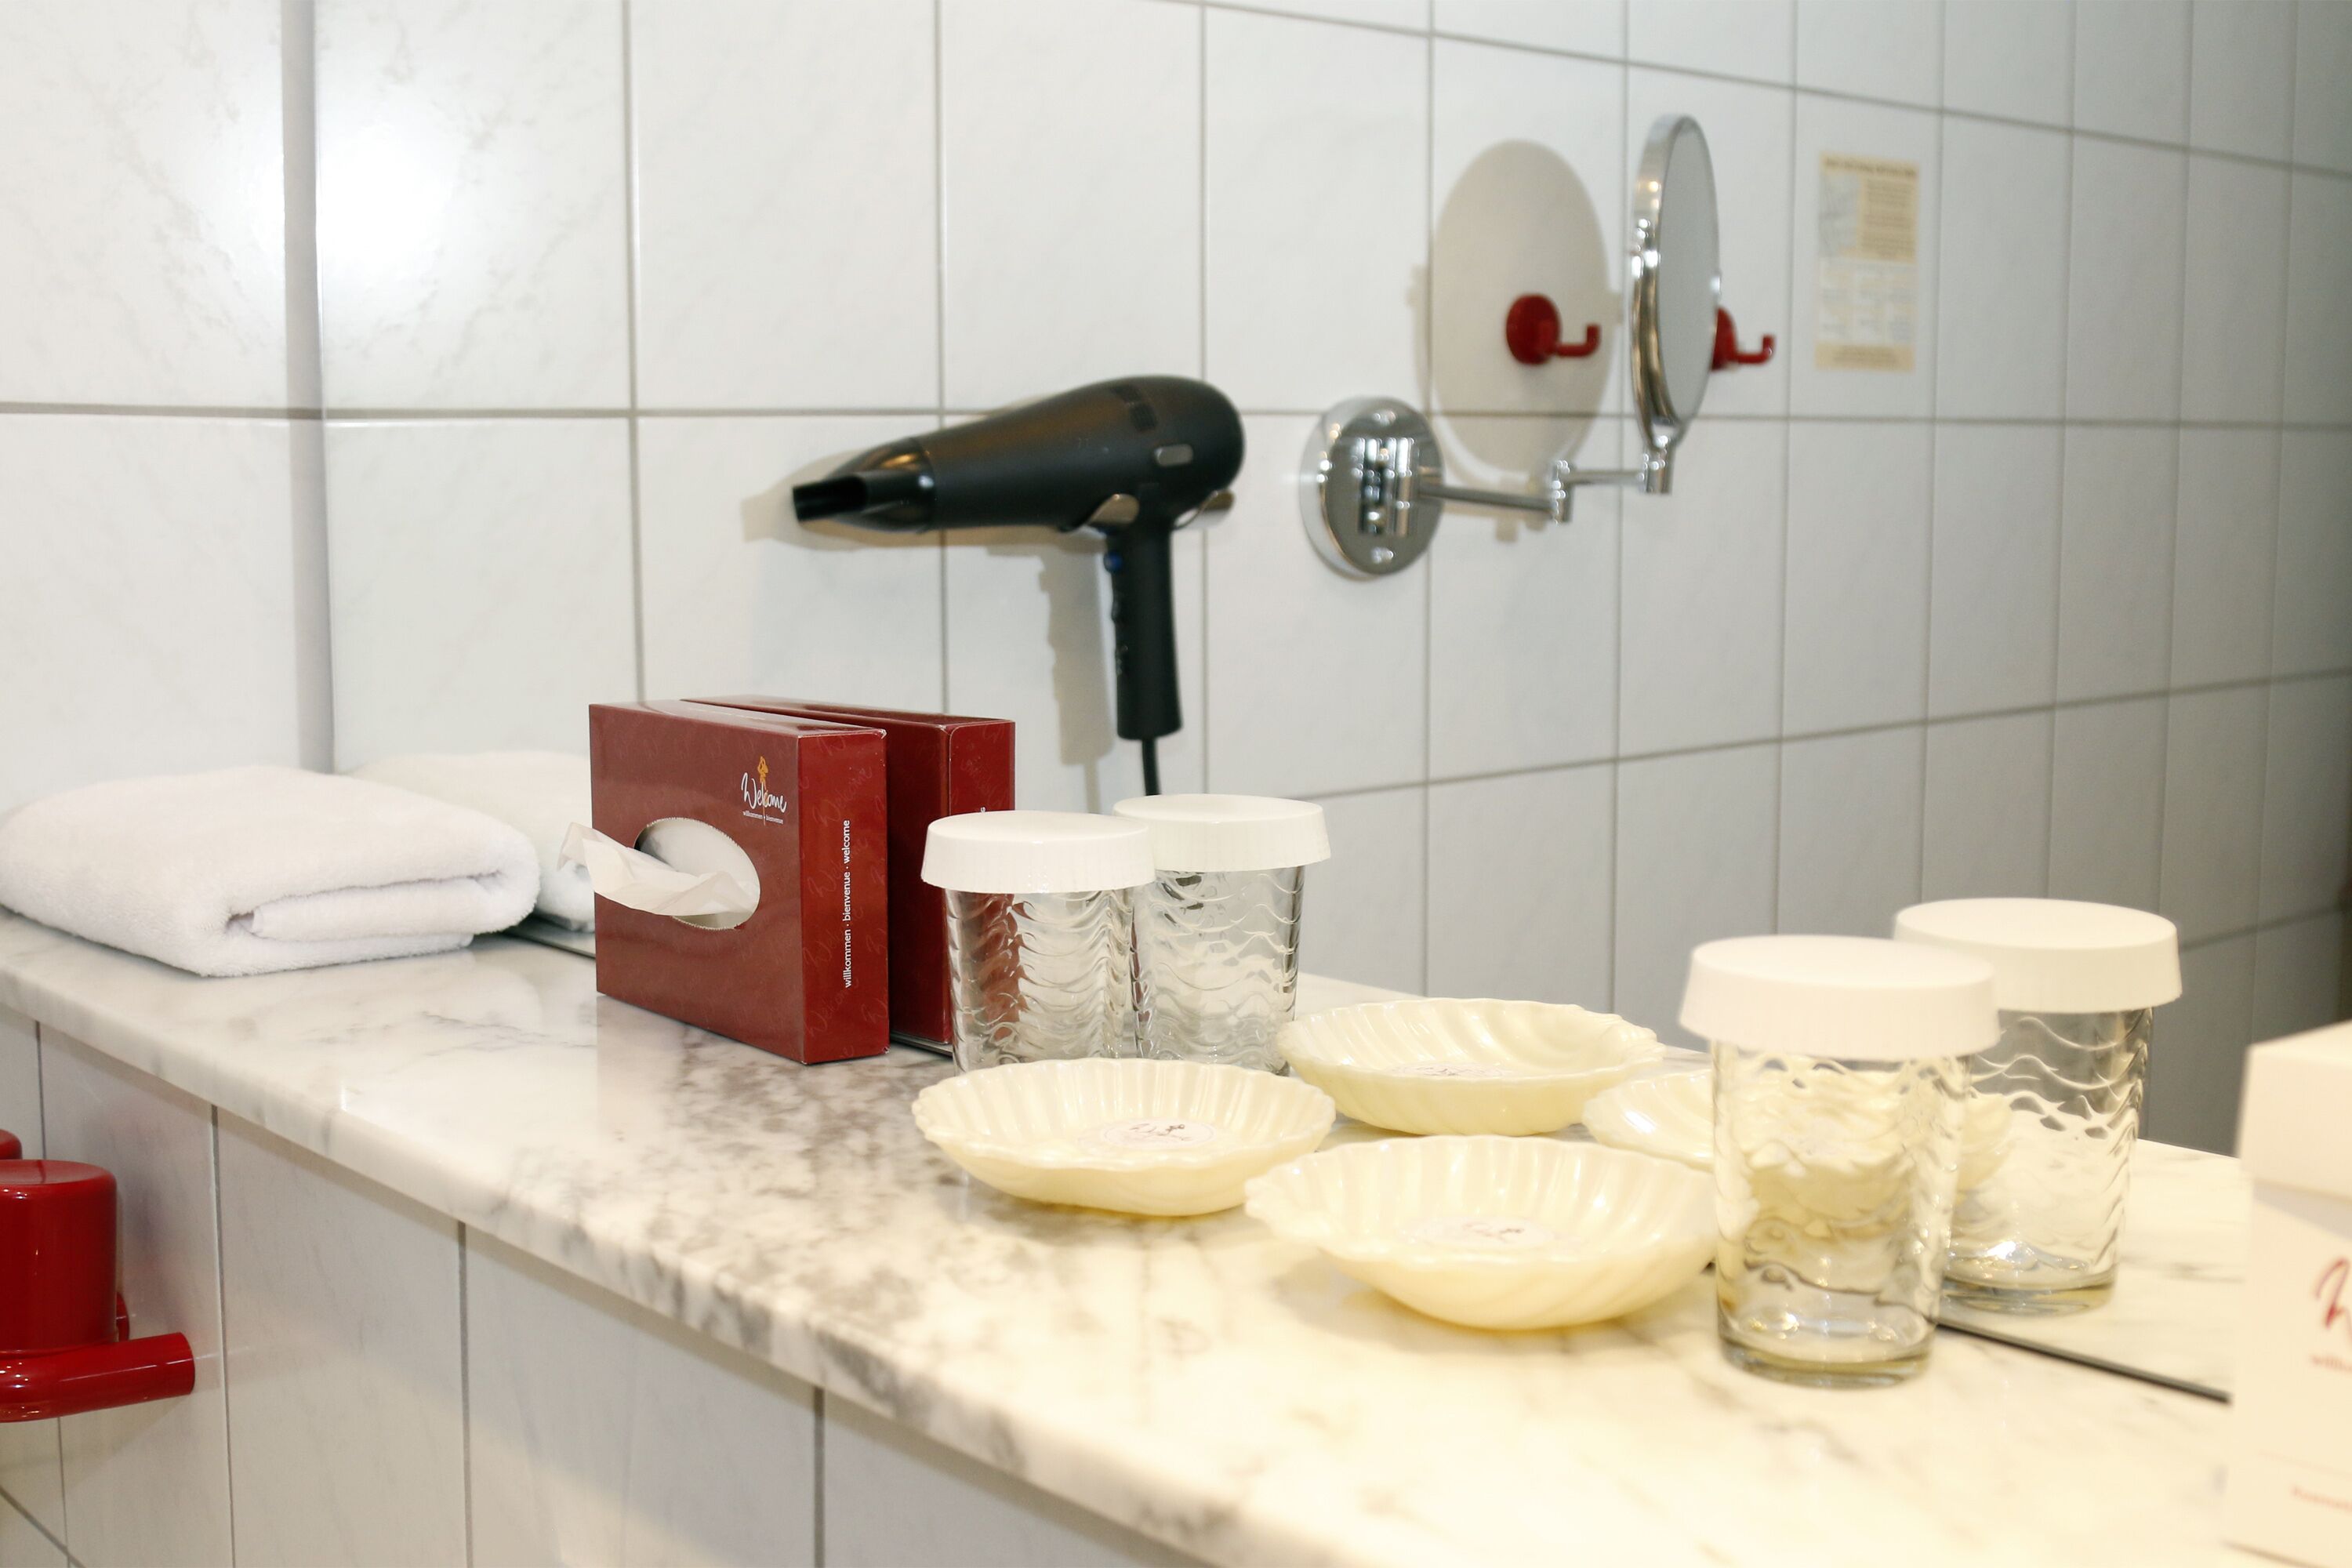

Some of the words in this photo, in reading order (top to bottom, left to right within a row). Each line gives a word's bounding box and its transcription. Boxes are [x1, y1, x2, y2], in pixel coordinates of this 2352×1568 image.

[741, 772, 787, 813] Welcome
[841, 820, 851, 864] welcome
[843, 929, 851, 988] willkommen
